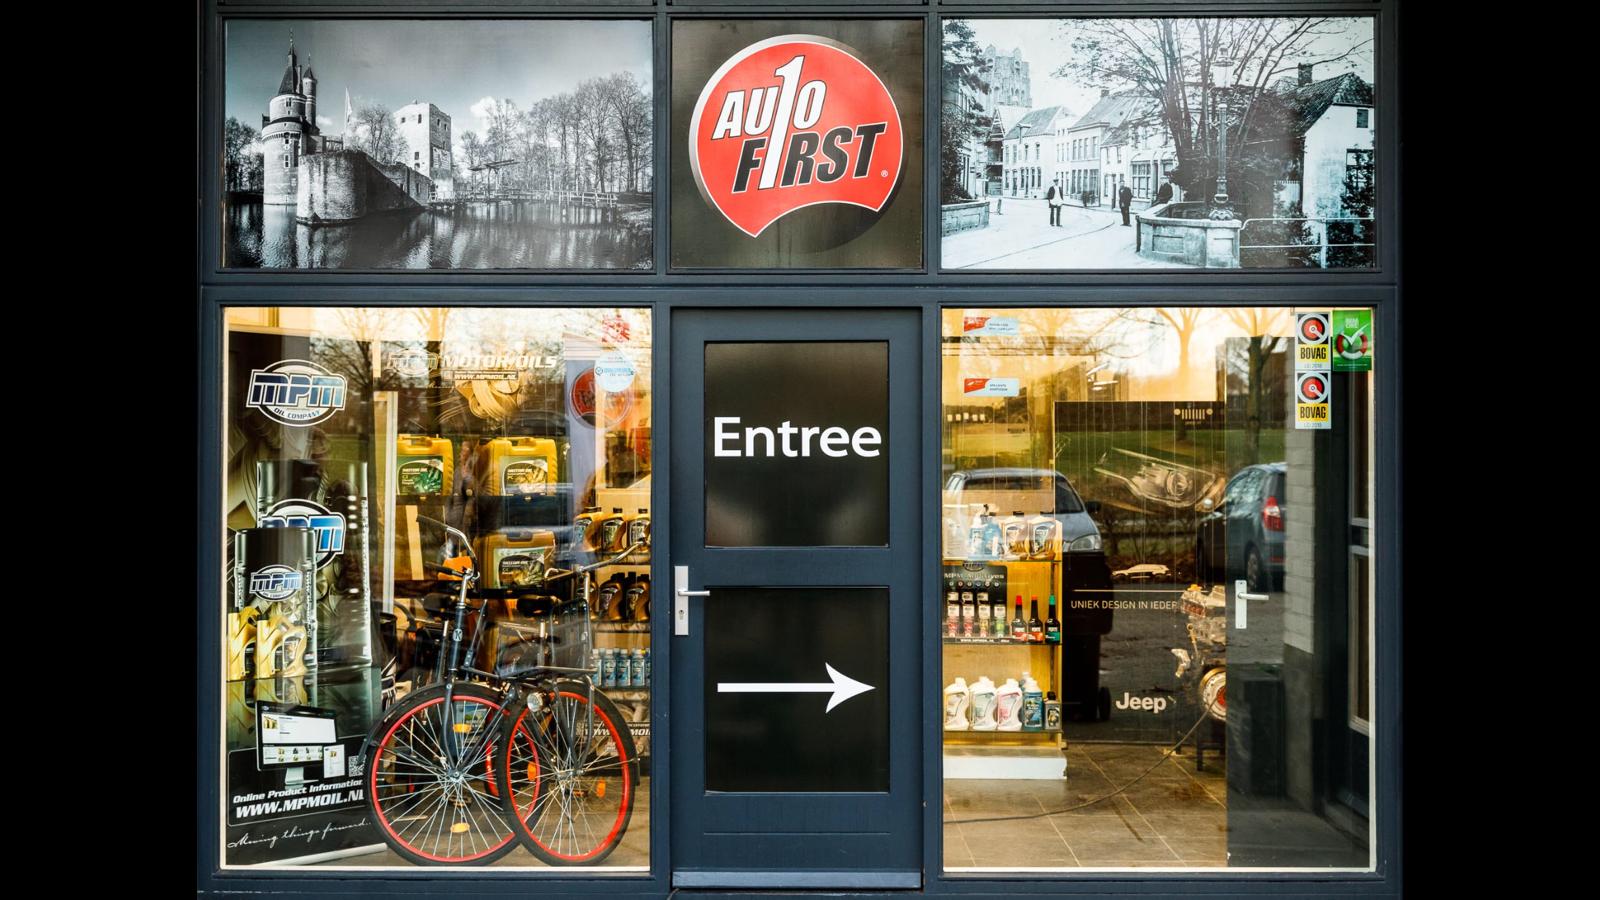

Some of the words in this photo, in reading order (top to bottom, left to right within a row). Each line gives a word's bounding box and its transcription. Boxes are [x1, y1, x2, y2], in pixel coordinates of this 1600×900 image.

[1300, 347, 1326, 360] BOVAG
[273, 407, 285, 417] OIL
[287, 409, 321, 420] COMPANY
[1300, 406, 1326, 419] BOVAG
[714, 416, 882, 458] Entree
[1070, 600, 1100, 609] UNIEK
[1101, 600, 1136, 610] DESIGN
[1138, 600, 1148, 610] IN
[1115, 692, 1167, 714] Jeep
[233, 792, 266, 804] Online
[267, 787, 308, 799] Product
